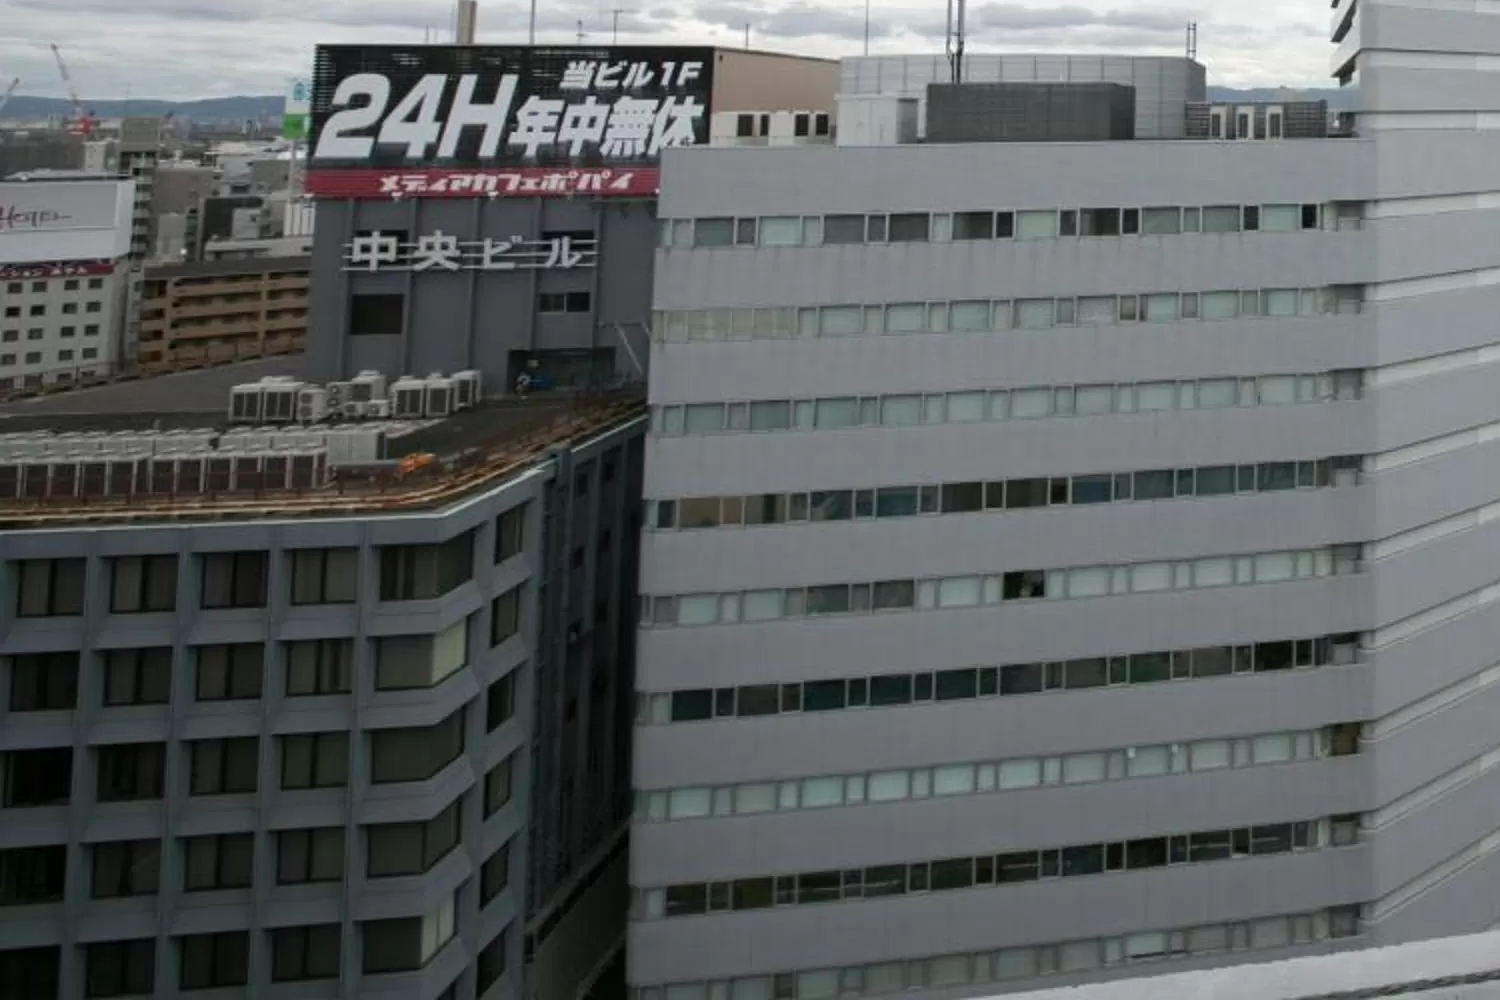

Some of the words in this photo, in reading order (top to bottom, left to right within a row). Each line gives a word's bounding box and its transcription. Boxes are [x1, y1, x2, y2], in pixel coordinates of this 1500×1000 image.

[314, 73, 518, 158] 24H
[508, 95, 704, 157] 年中無休
[379, 171, 634, 193] メディアカフェポパイ
[351, 230, 582, 272] 中央ビル
